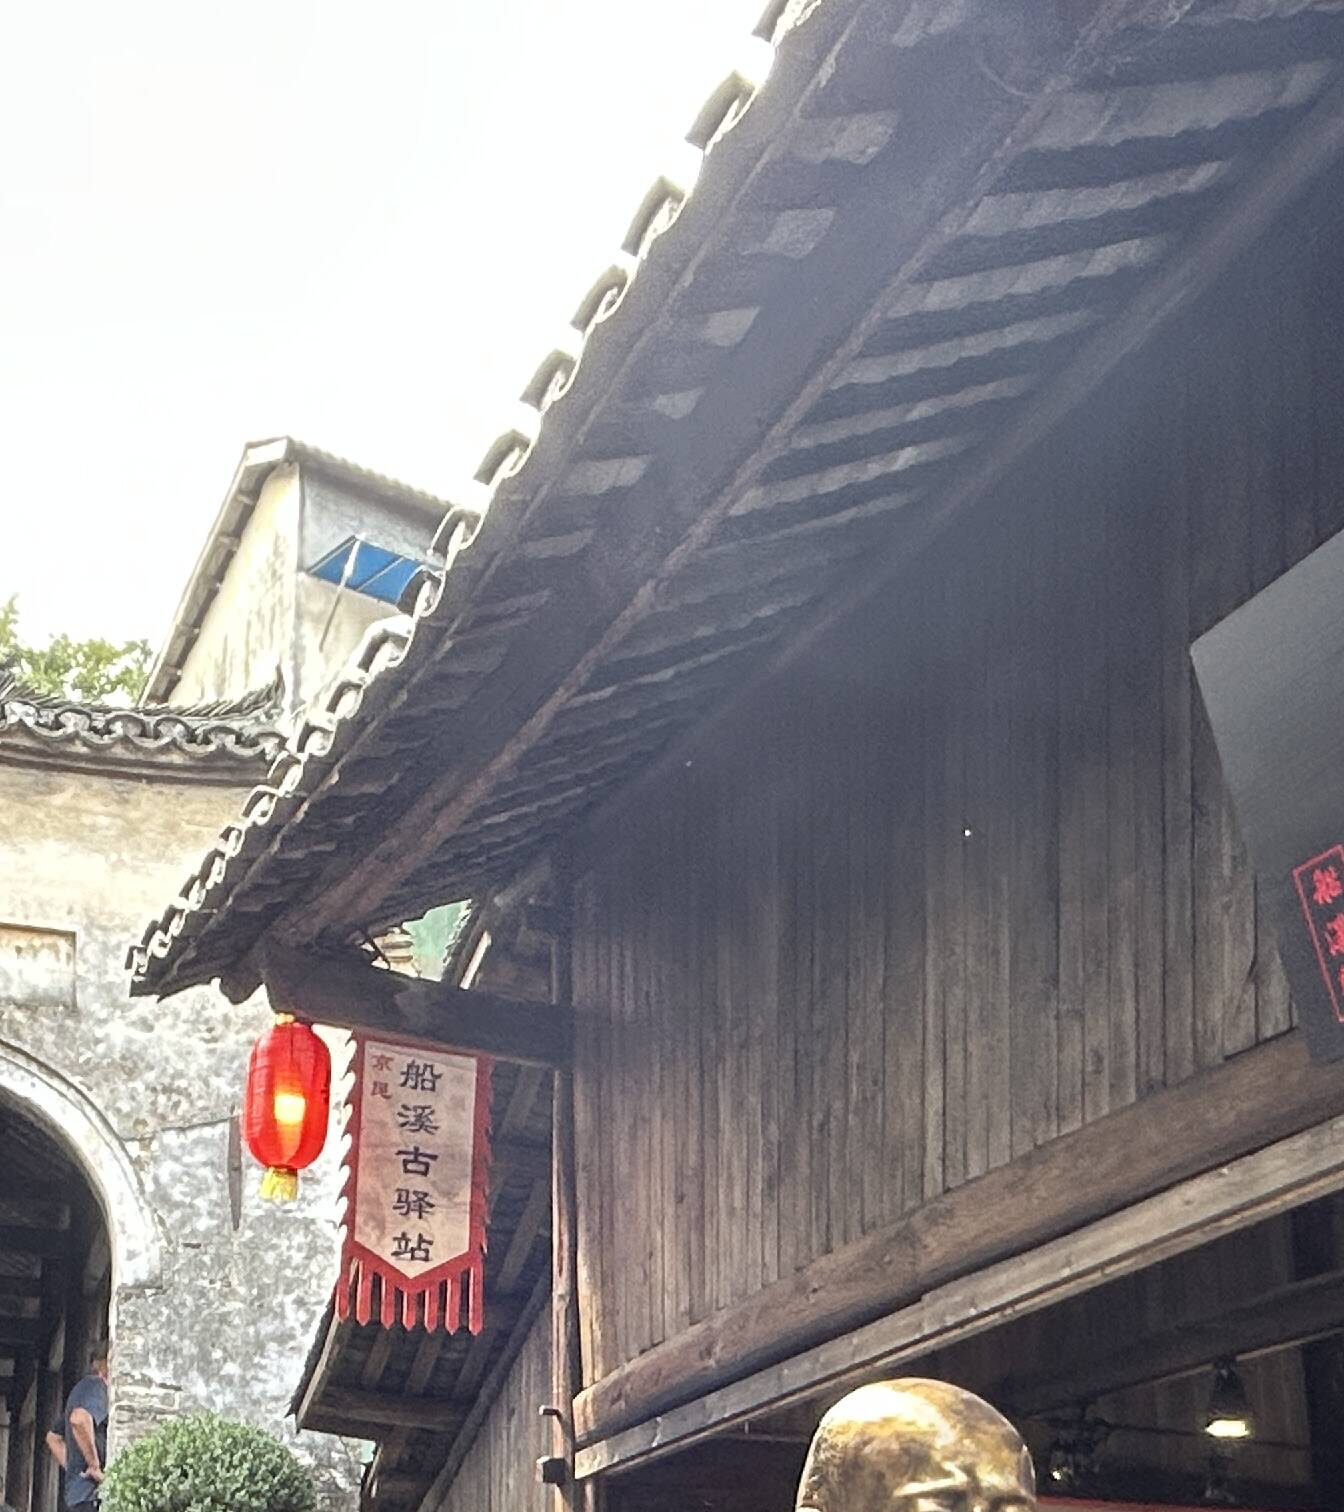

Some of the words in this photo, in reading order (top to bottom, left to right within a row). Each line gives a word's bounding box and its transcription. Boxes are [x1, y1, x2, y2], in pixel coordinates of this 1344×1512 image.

[370, 1054, 395, 1100] 京昆
[391, 1058, 443, 1262] 船溪古驿站
